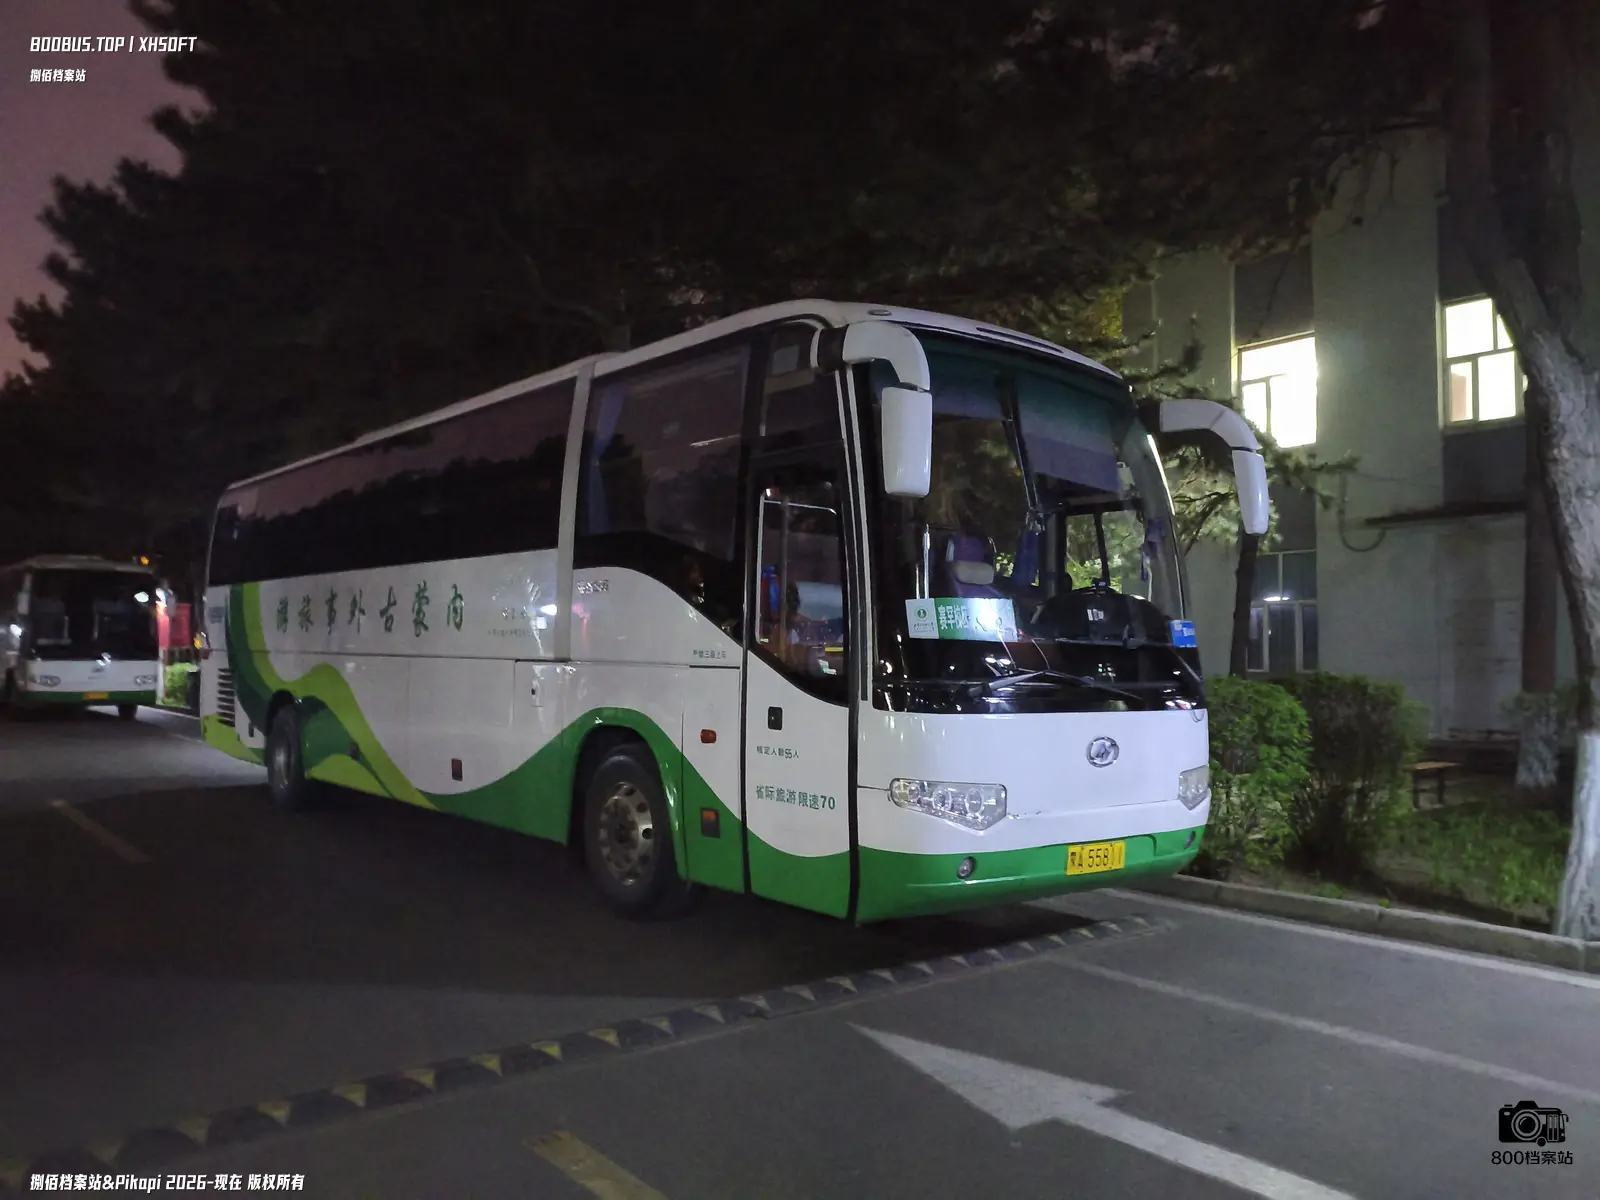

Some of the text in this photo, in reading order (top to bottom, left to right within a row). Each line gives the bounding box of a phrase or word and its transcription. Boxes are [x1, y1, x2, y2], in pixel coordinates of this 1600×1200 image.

[756, 745, 800, 759] 核定人数55人
